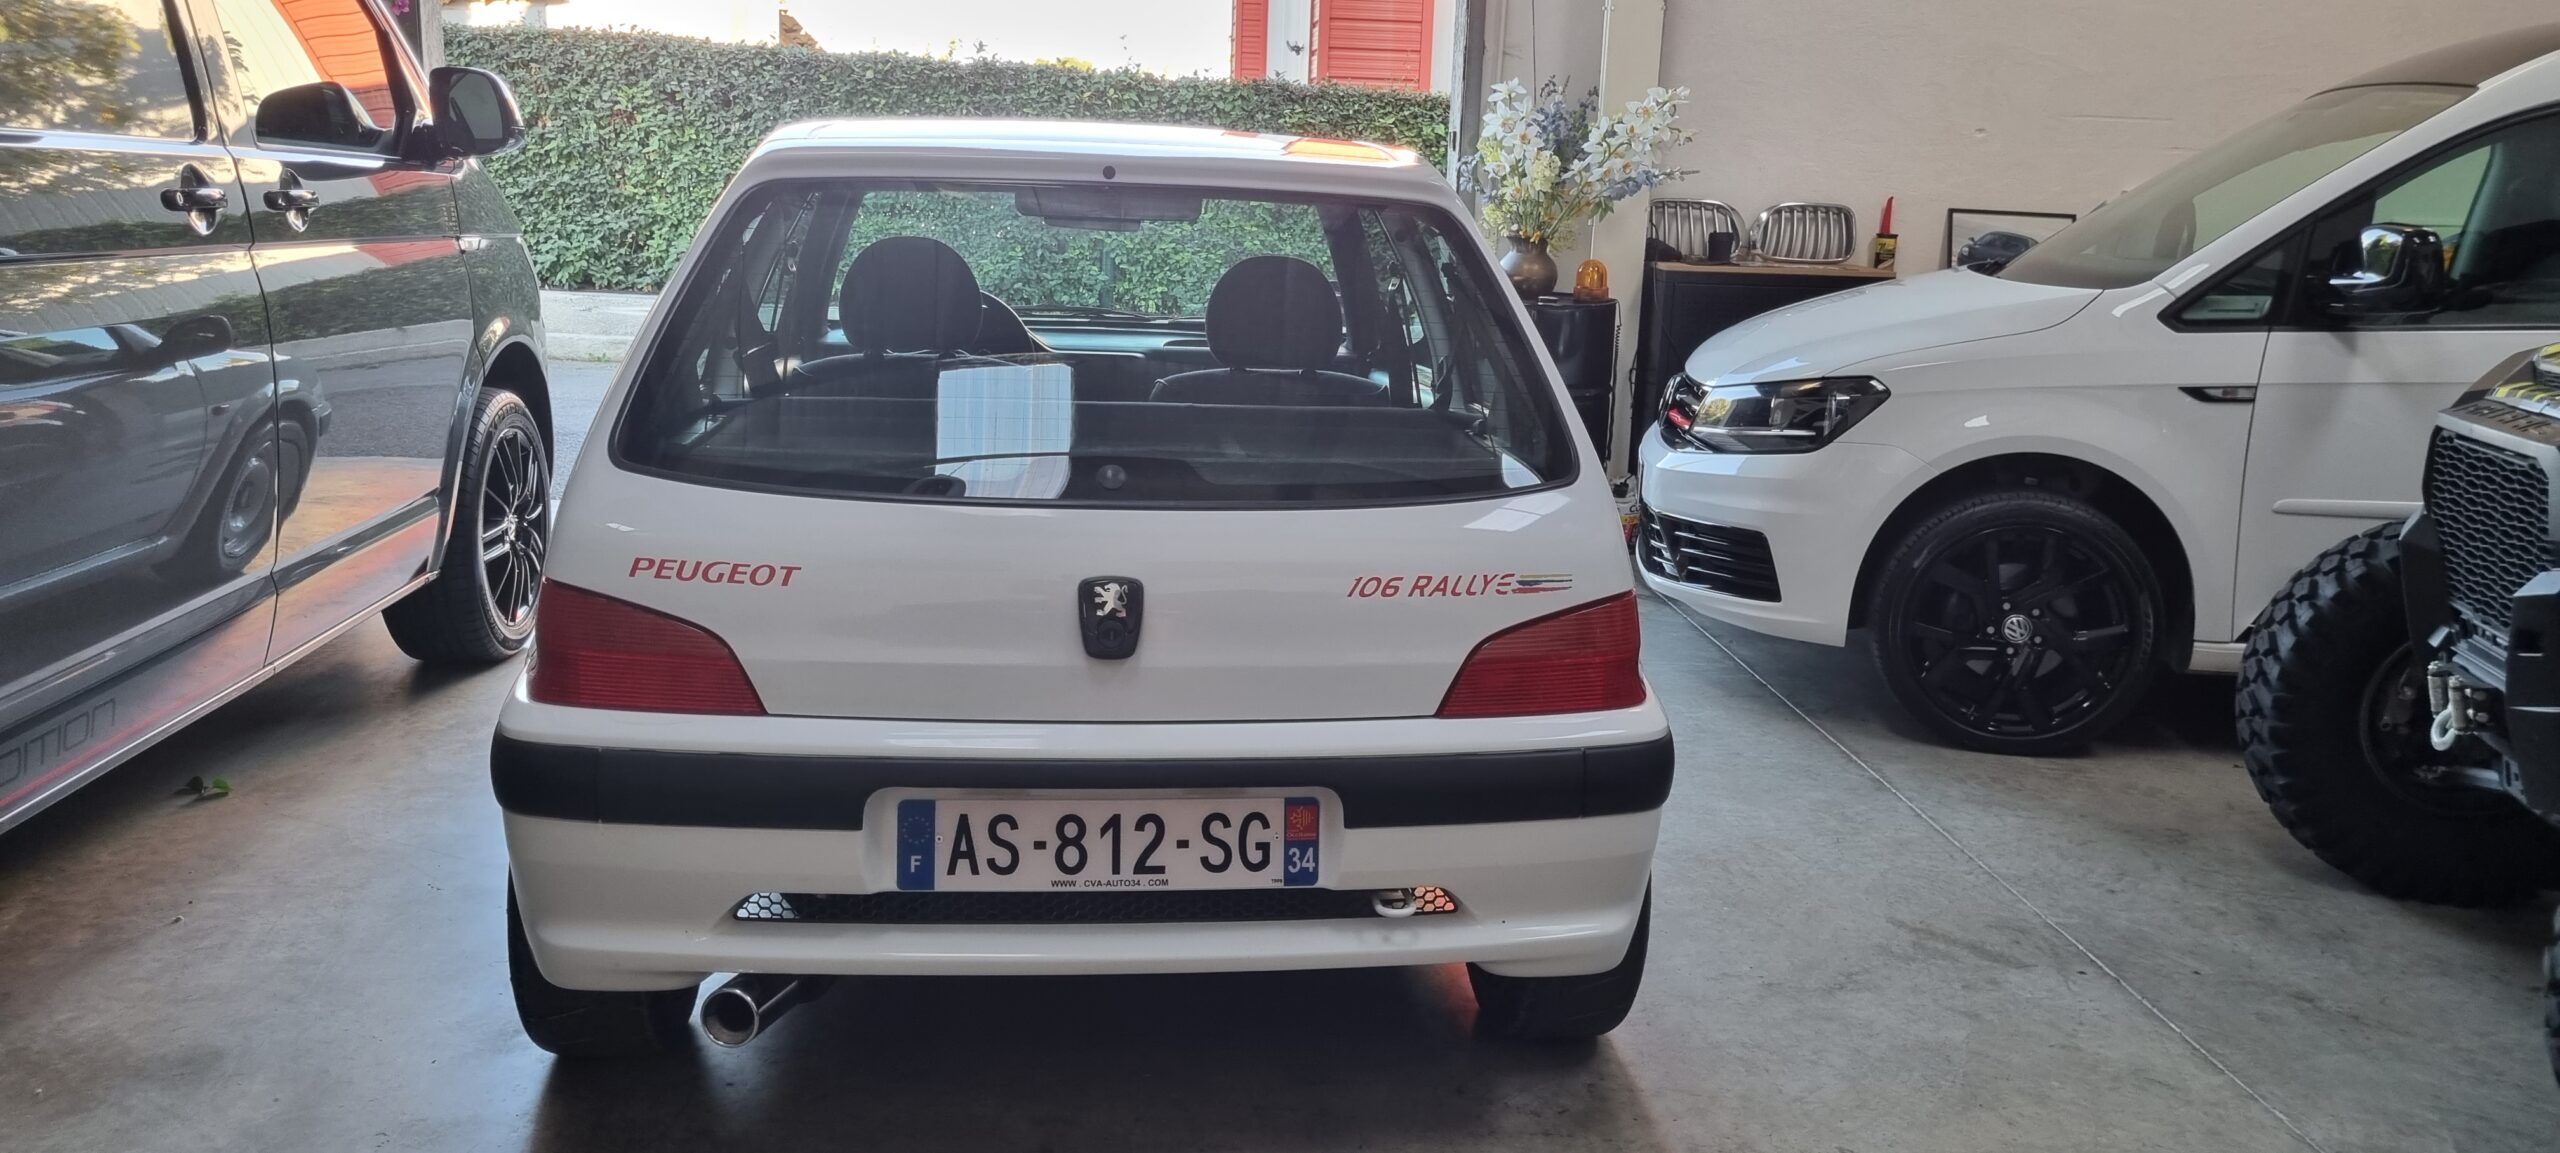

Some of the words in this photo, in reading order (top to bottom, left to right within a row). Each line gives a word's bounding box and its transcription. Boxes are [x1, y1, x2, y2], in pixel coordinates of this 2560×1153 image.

[628, 556, 802, 587] PEUGEOT
[1346, 575, 1403, 598] 106
[1407, 573, 1516, 598] RALLYE
[946, 811, 1271, 876] AS-812-SG
[910, 855, 921, 873] F
[1287, 846, 1316, 873] 34
